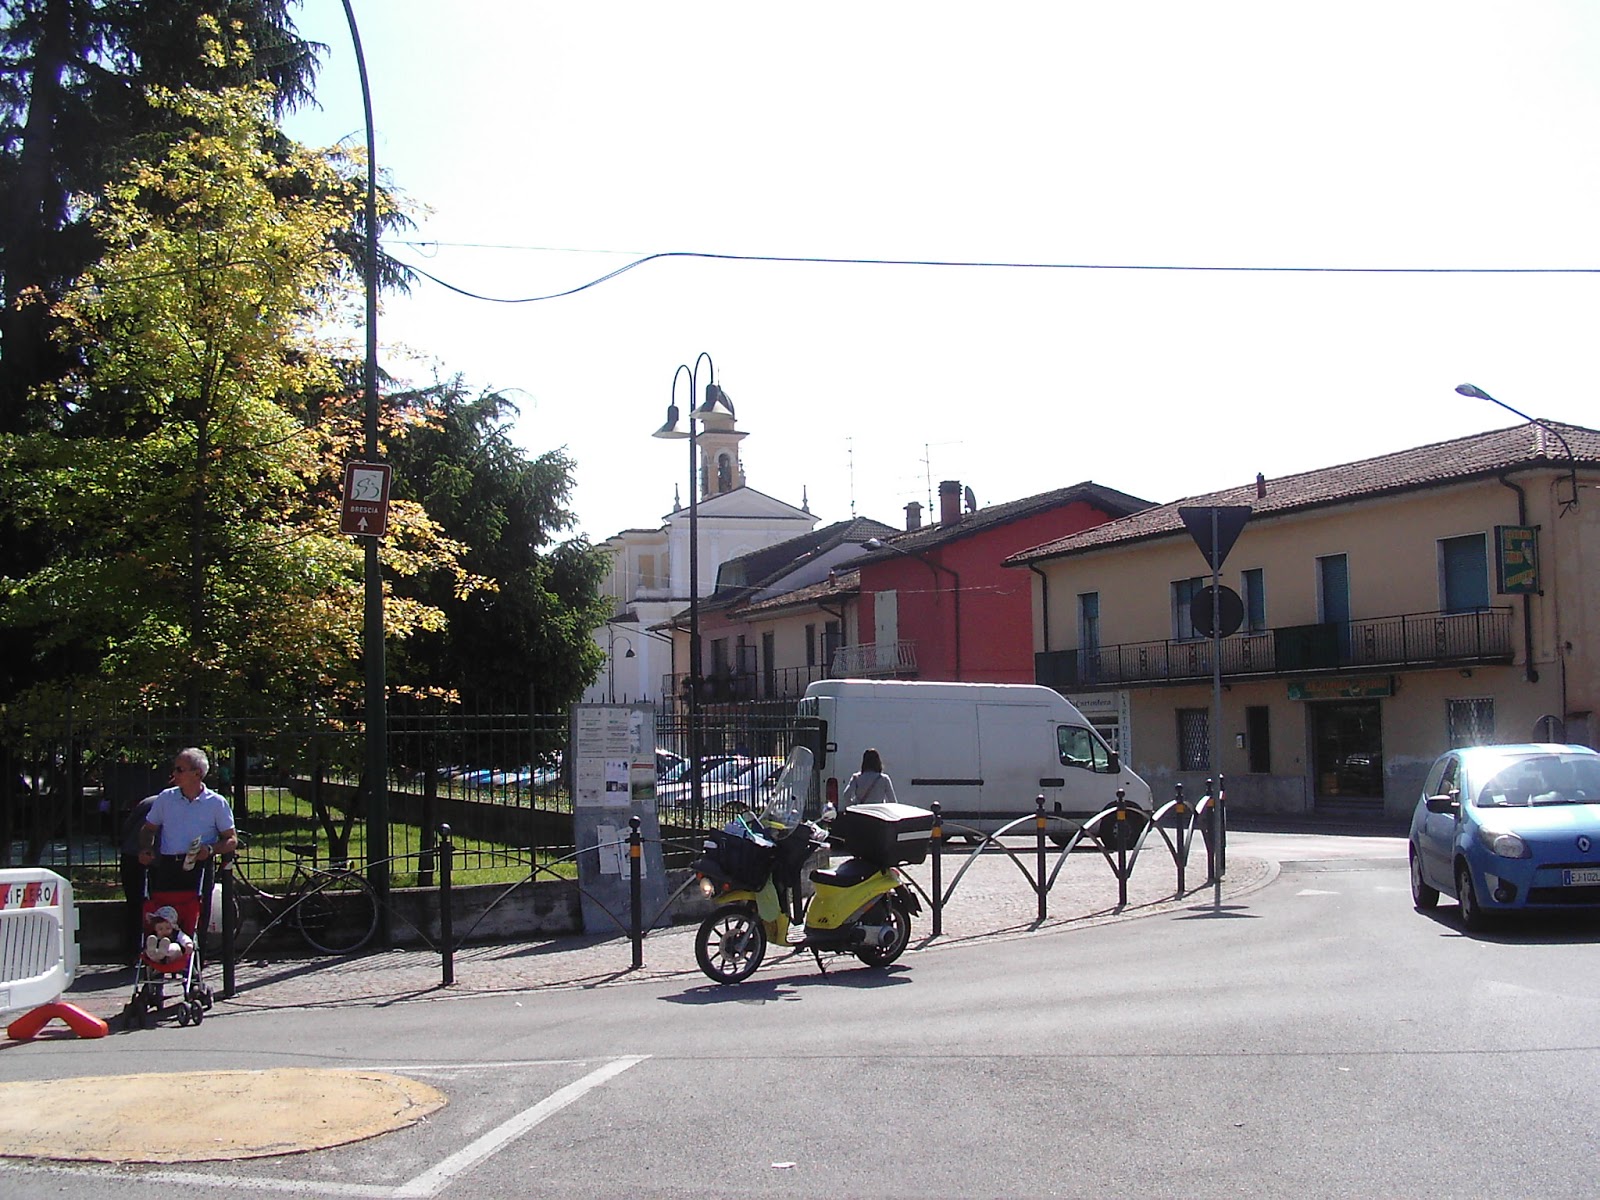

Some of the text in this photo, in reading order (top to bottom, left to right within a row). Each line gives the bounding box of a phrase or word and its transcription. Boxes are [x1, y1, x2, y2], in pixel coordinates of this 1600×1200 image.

[350, 505, 379, 514] BRESCIA
[1121, 692, 1130, 766] CARTOLERI
[16, 887, 51, 904] FLERO
